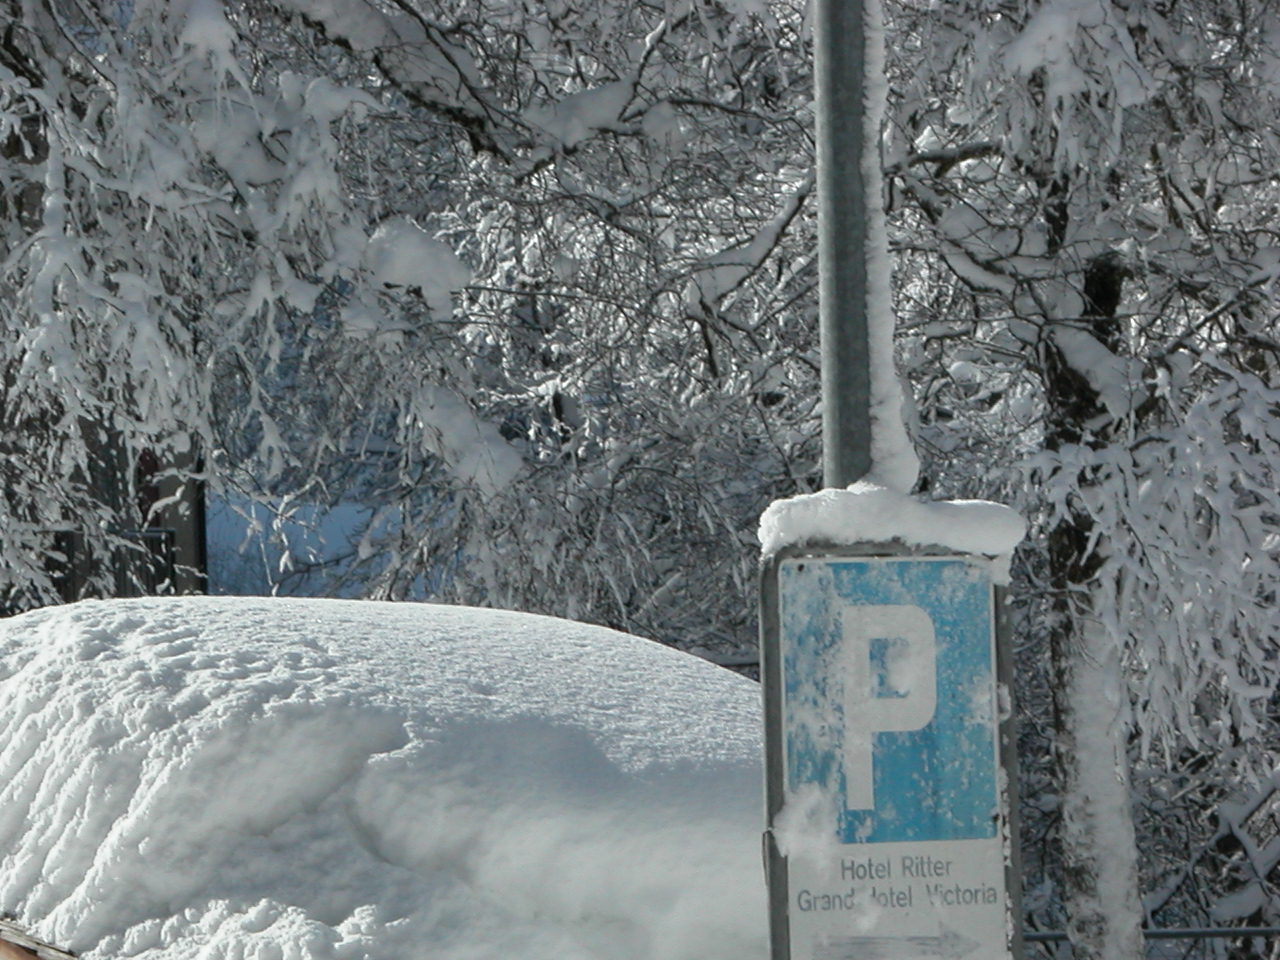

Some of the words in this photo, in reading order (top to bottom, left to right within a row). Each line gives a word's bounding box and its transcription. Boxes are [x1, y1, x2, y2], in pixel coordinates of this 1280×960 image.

[842, 604, 937, 811] P
[840, 858, 891, 880] Hotel
[902, 855, 953, 878] Ritter
[796, 887, 856, 912] Grand
[926, 882, 998, 907] Victoria
